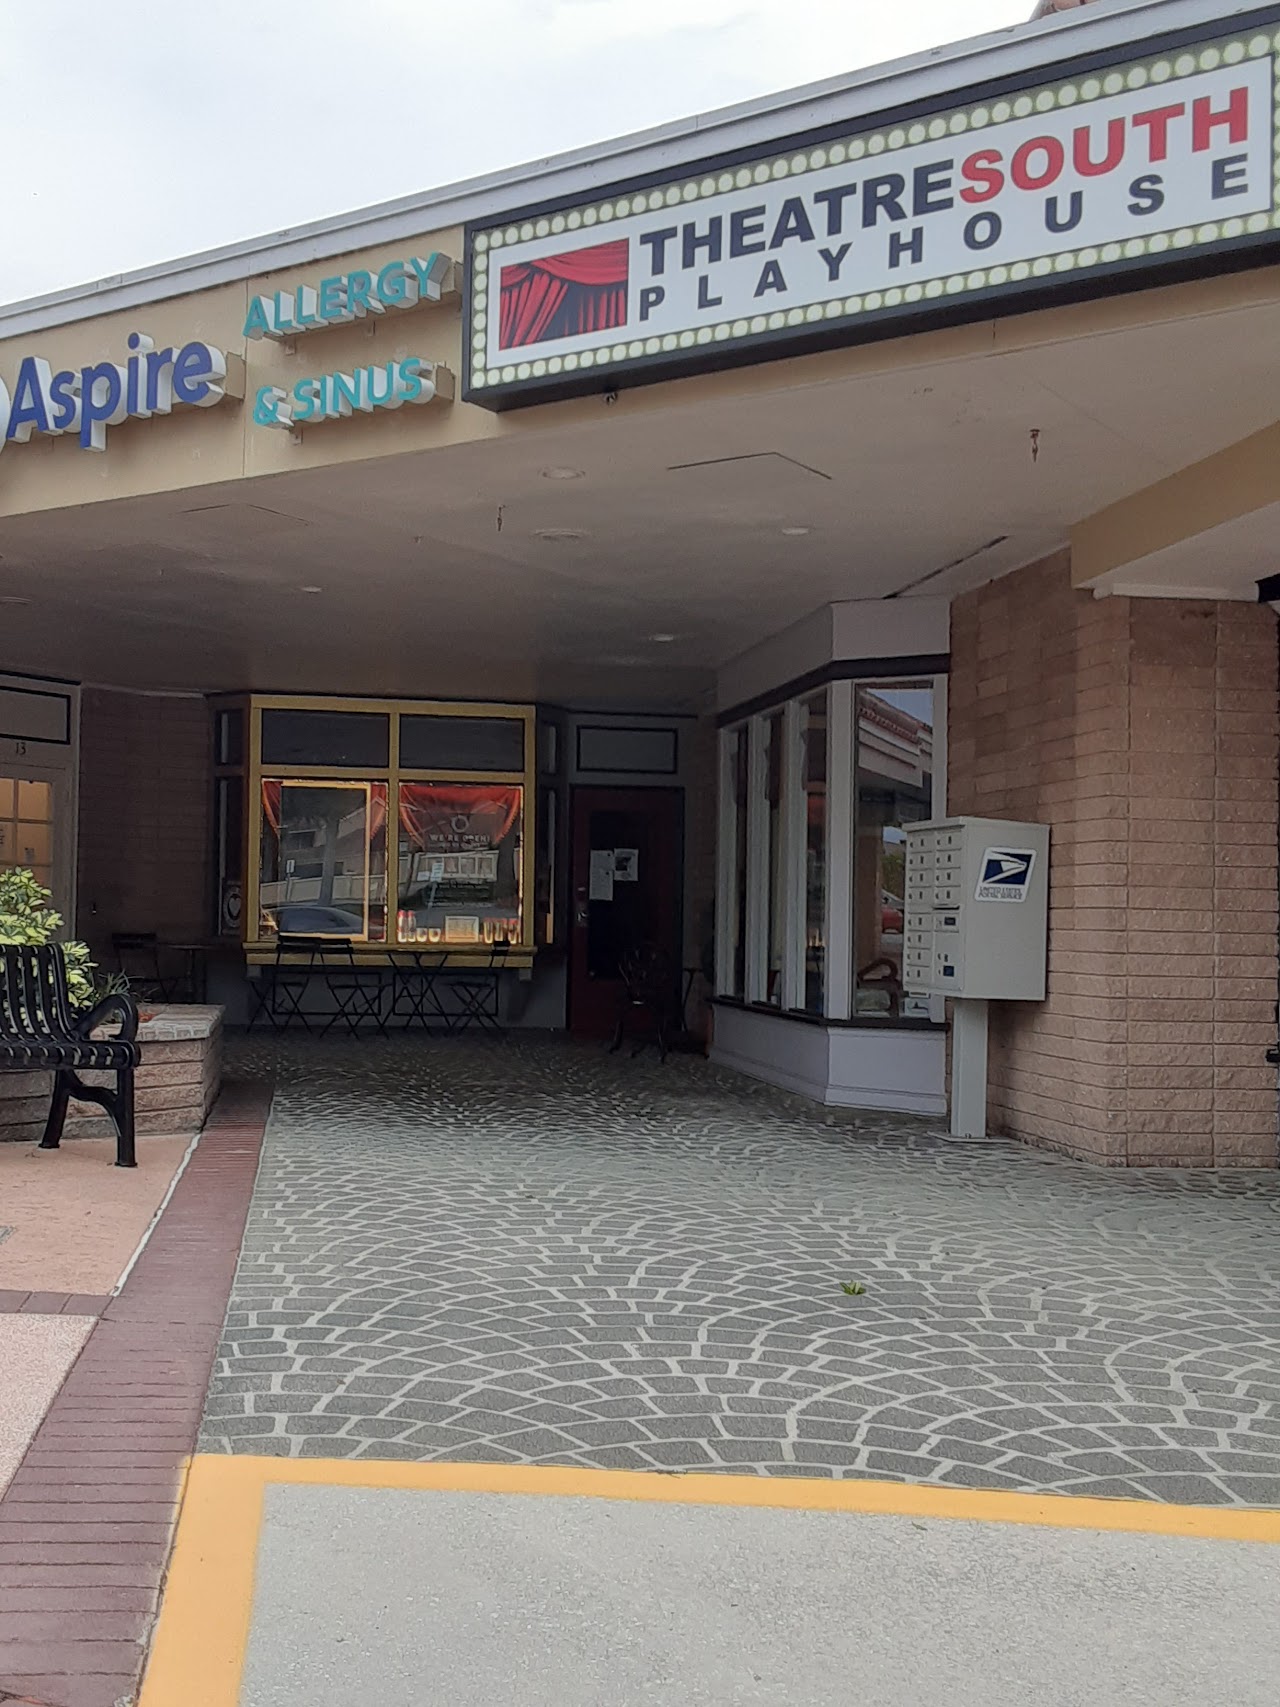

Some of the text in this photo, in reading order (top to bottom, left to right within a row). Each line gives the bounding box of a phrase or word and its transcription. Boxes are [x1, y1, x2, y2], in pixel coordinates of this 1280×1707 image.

[242, 252, 440, 337] ALLERGY
[6, 332, 214, 449] Aspire
[253, 358, 424, 427] & SINUS
[15, 742, 27, 755] 13
